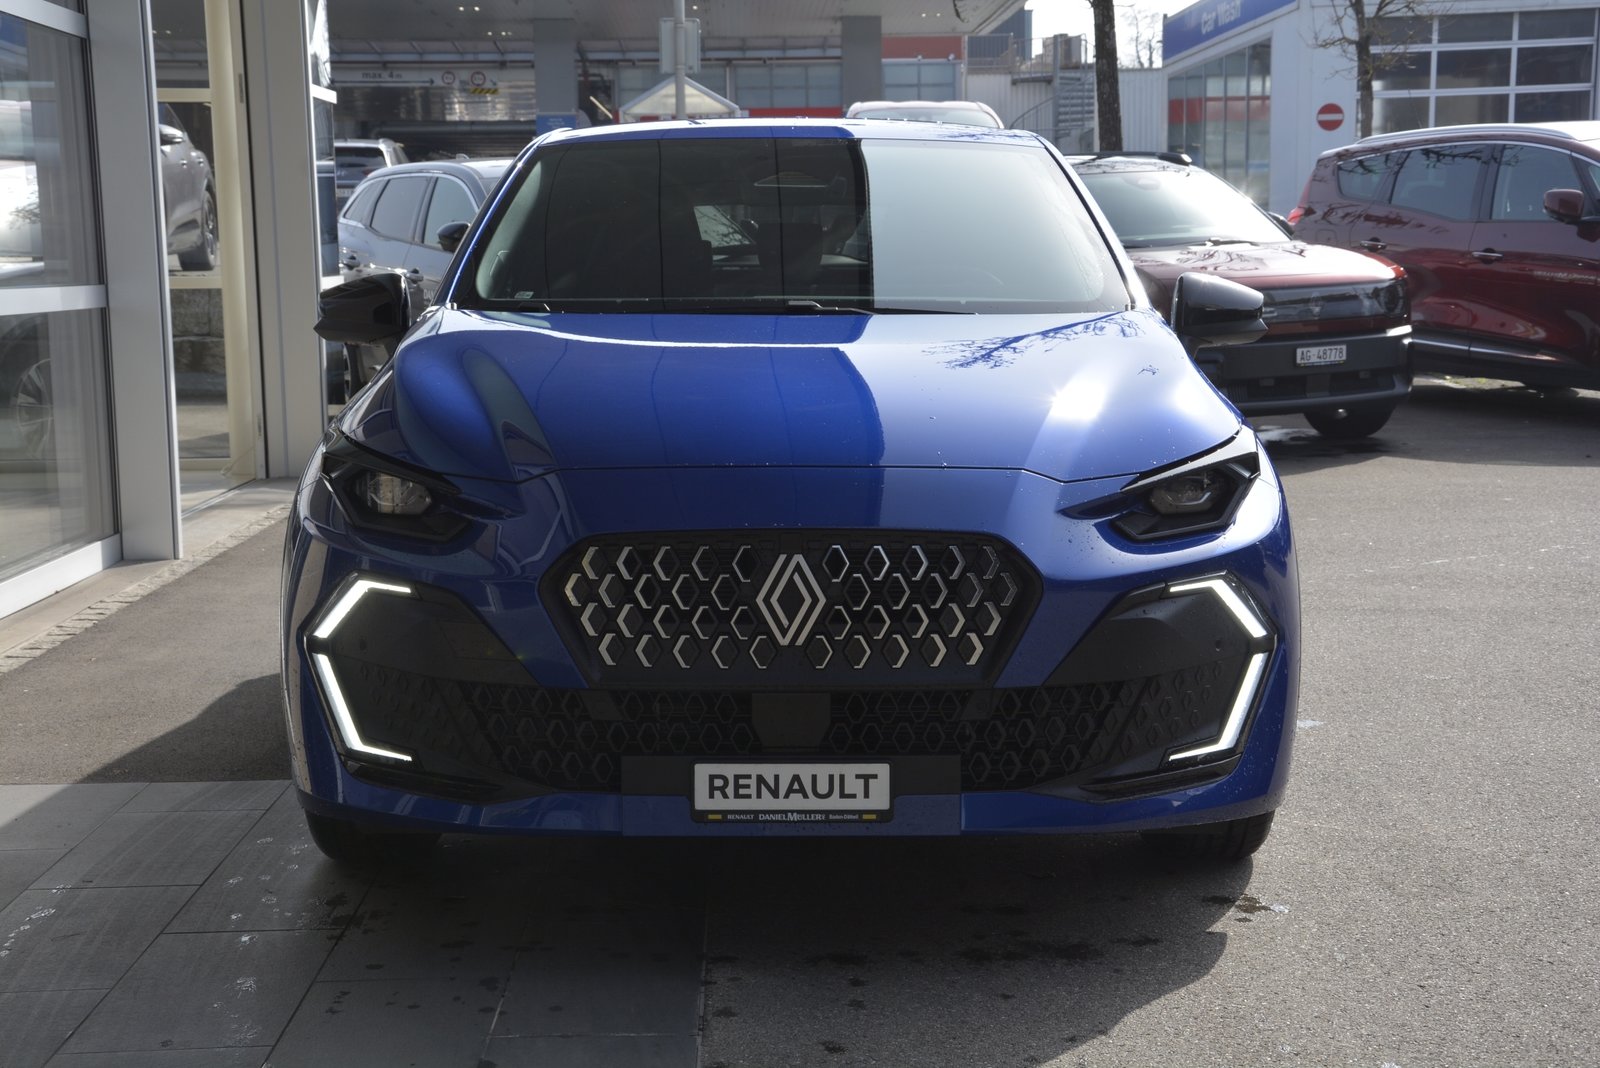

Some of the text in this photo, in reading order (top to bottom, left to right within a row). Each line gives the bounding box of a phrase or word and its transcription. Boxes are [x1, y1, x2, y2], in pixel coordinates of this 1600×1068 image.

[1201, 0, 1241, 35] Car Wash
[708, 773, 878, 800] RENAULT
